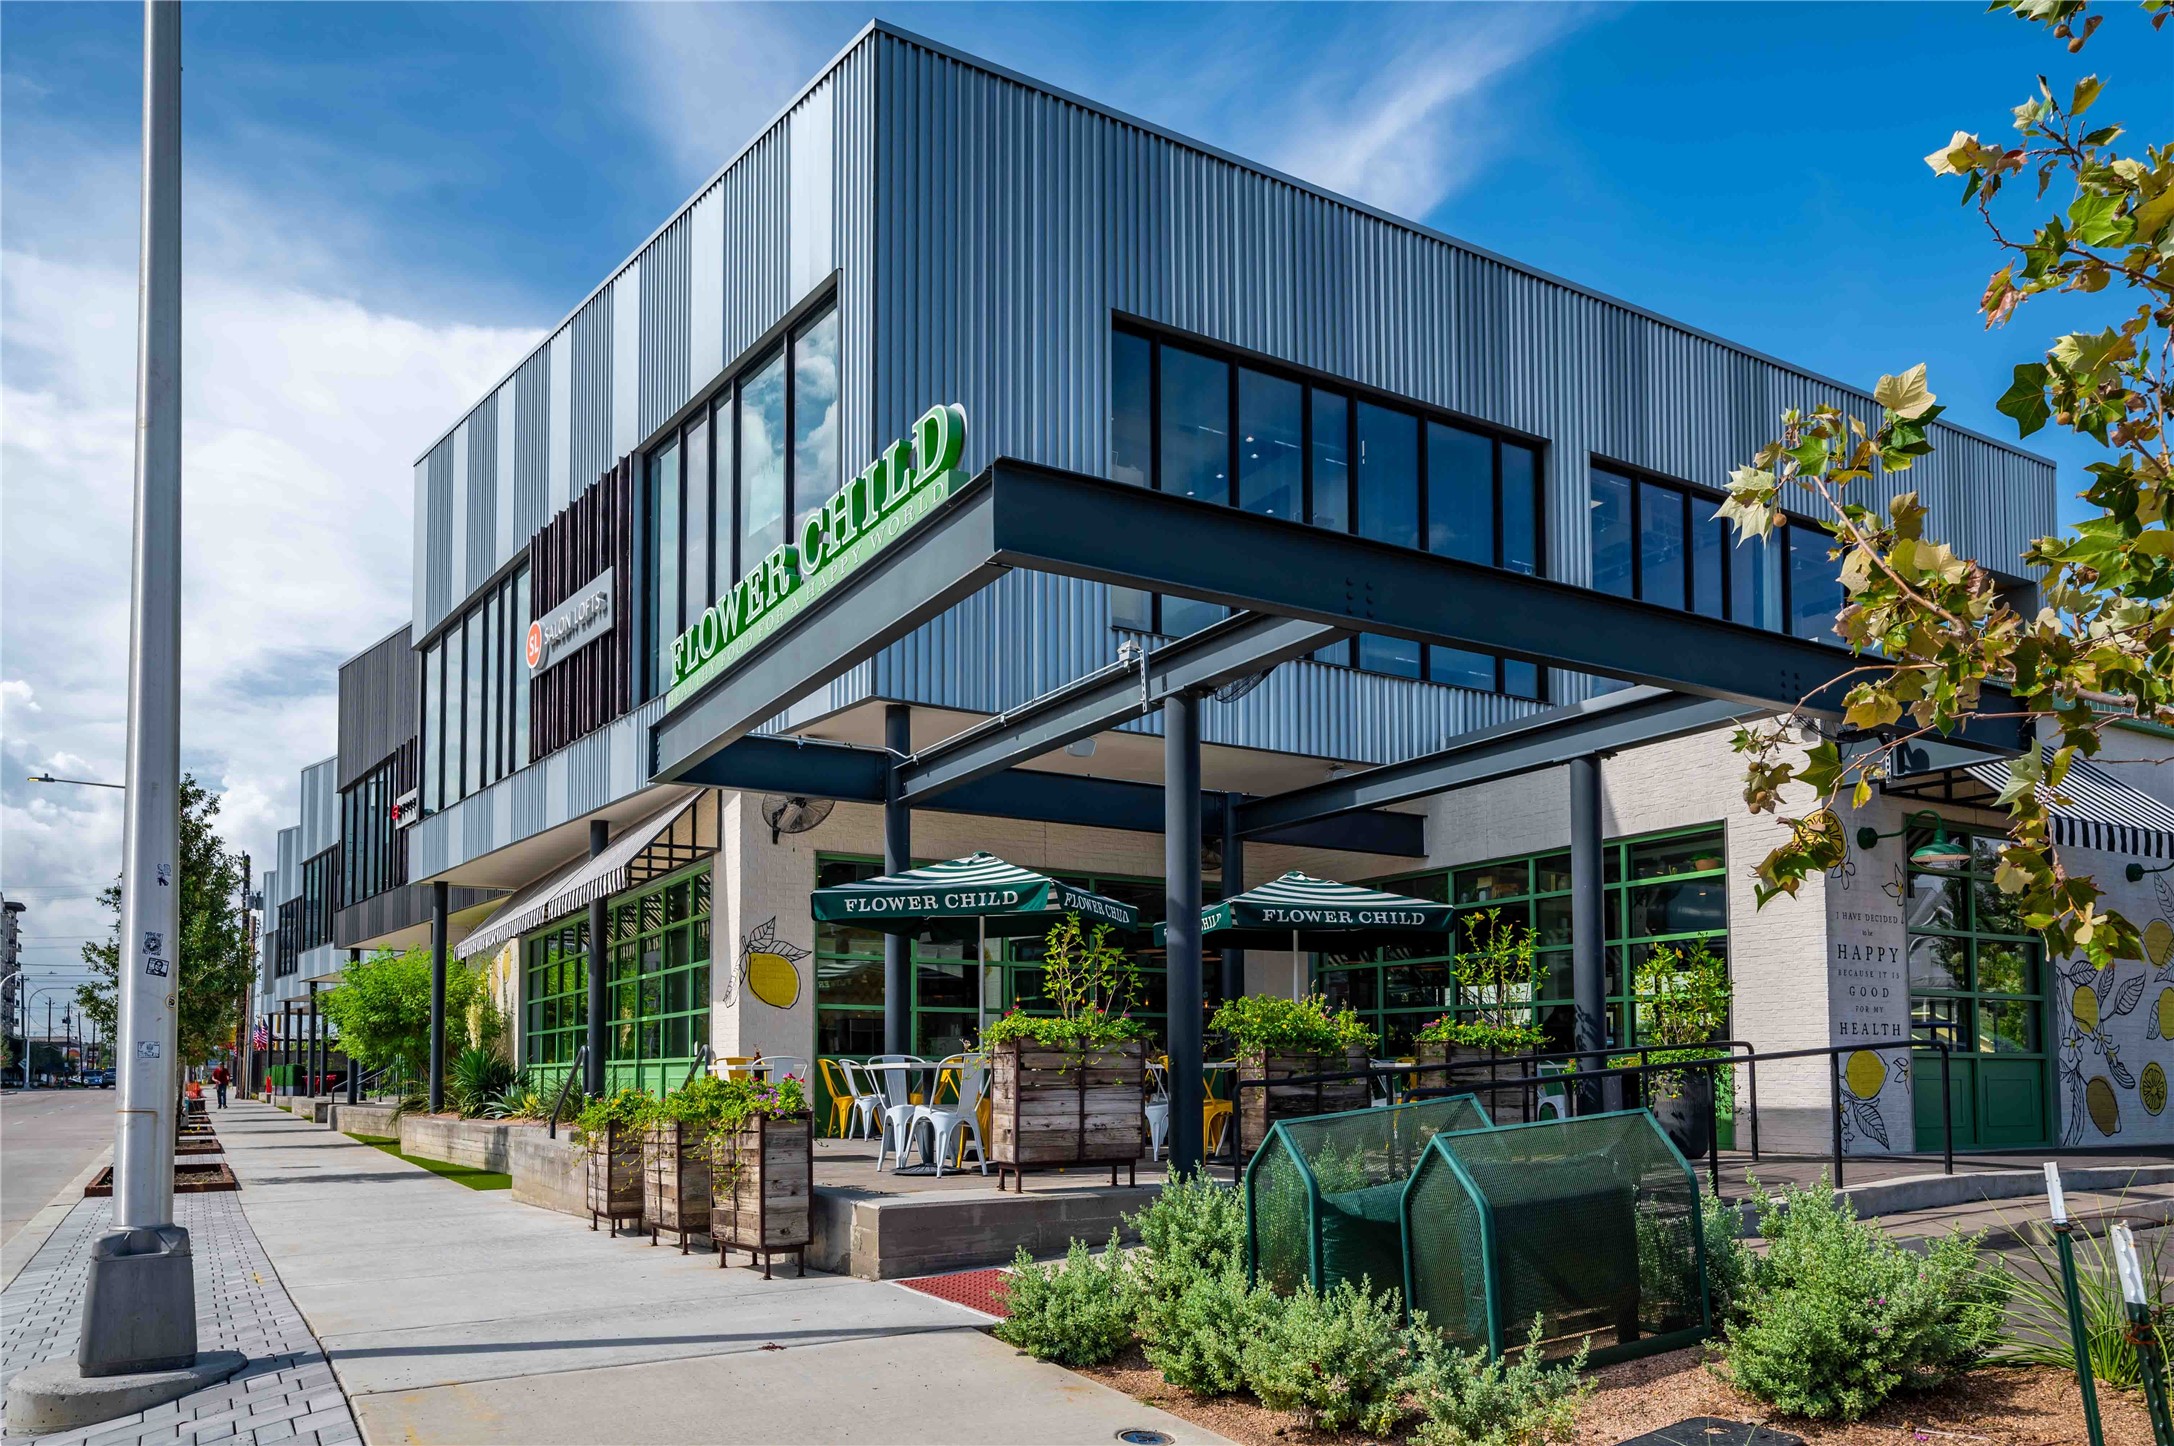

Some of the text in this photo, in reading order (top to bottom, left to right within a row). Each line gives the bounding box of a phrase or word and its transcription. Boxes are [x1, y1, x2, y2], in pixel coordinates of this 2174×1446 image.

[670, 404, 949, 687] FLOWER CHILD
[667, 481, 945, 708] HEALTHY FOOD FOR A HAPPY WORLD
[544, 591, 605, 645] SALON LOFTS
[529, 633, 540, 657] SL
[844, 890, 1019, 913] FLOWER CHILD
[1064, 893, 1130, 924] FLOWER CHILD
[1262, 909, 1426, 926] FLOWER CHILD
[1842, 911, 1862, 921] HAVE
[1865, 913, 1898, 925] DECIDED
[1837, 943, 1899, 963] HAPPY
[1838, 968, 1874, 978] BECAUSE
[1878, 971, 1887, 979] IT
[1849, 985, 1889, 998] GOOD
[1855, 1005, 1870, 1013] FOR
[1839, 1022, 1901, 1036] HEALTH
